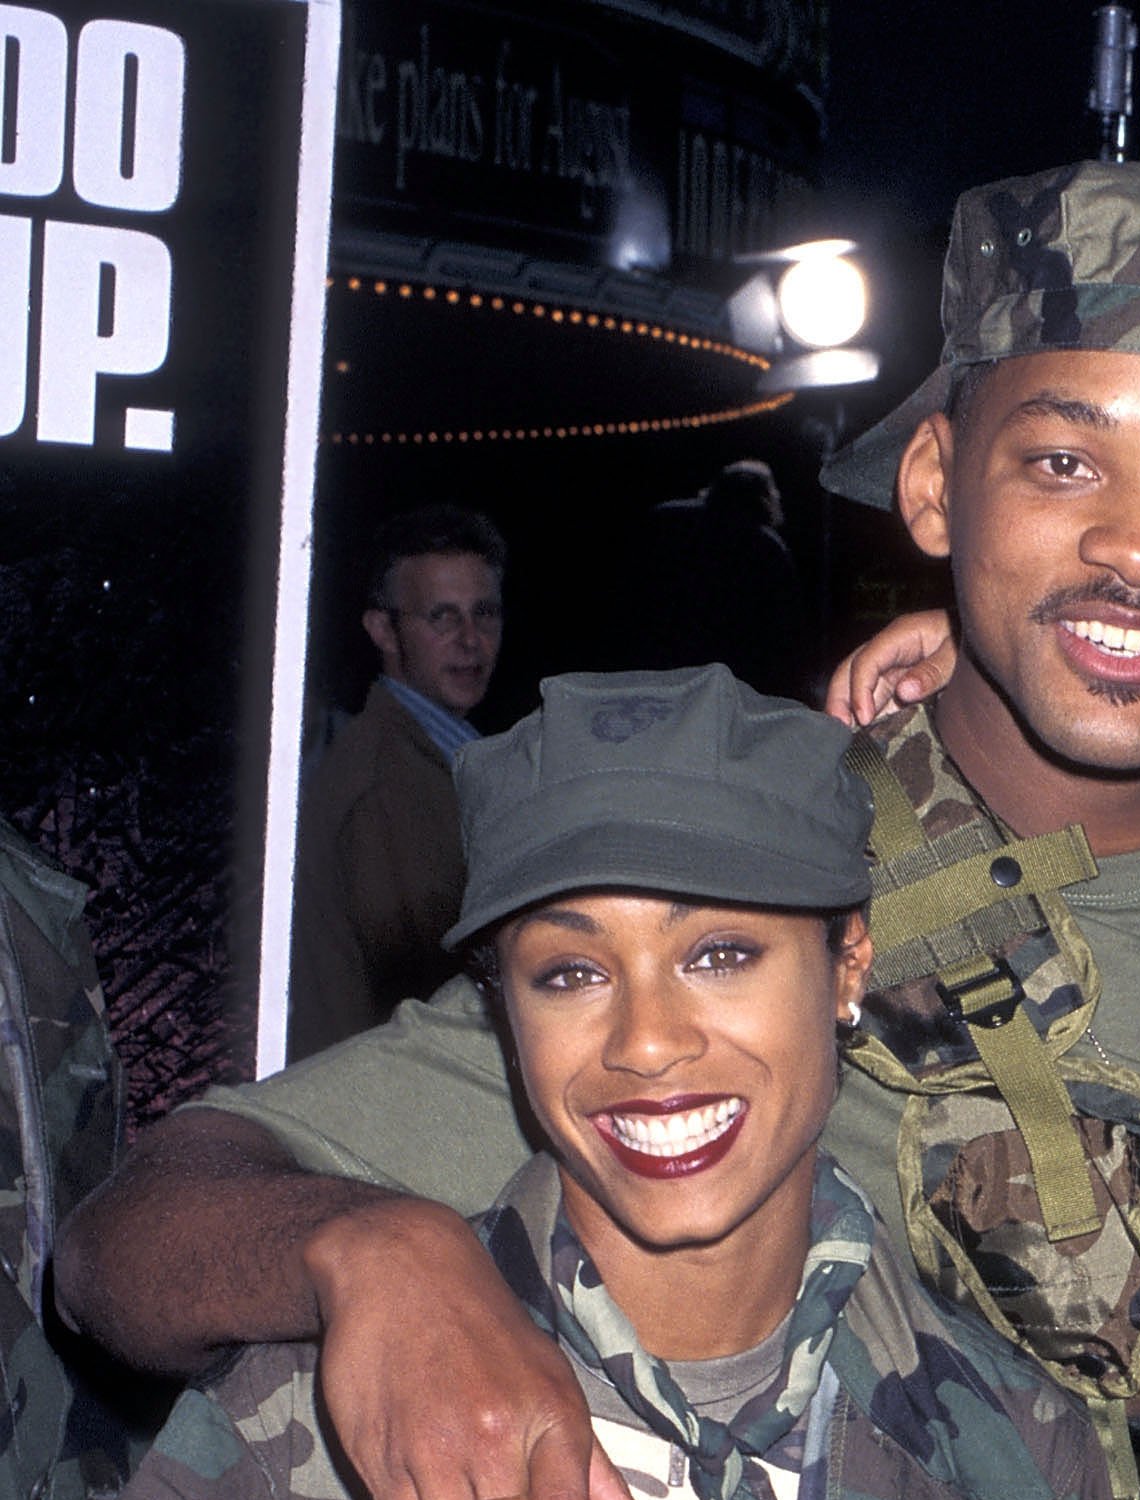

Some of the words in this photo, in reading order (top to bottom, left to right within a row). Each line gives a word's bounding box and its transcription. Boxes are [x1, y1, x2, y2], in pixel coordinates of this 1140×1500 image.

[0, 4, 186, 213] DO
[395, 22, 483, 190] plans
[494, 38, 539, 171] for
